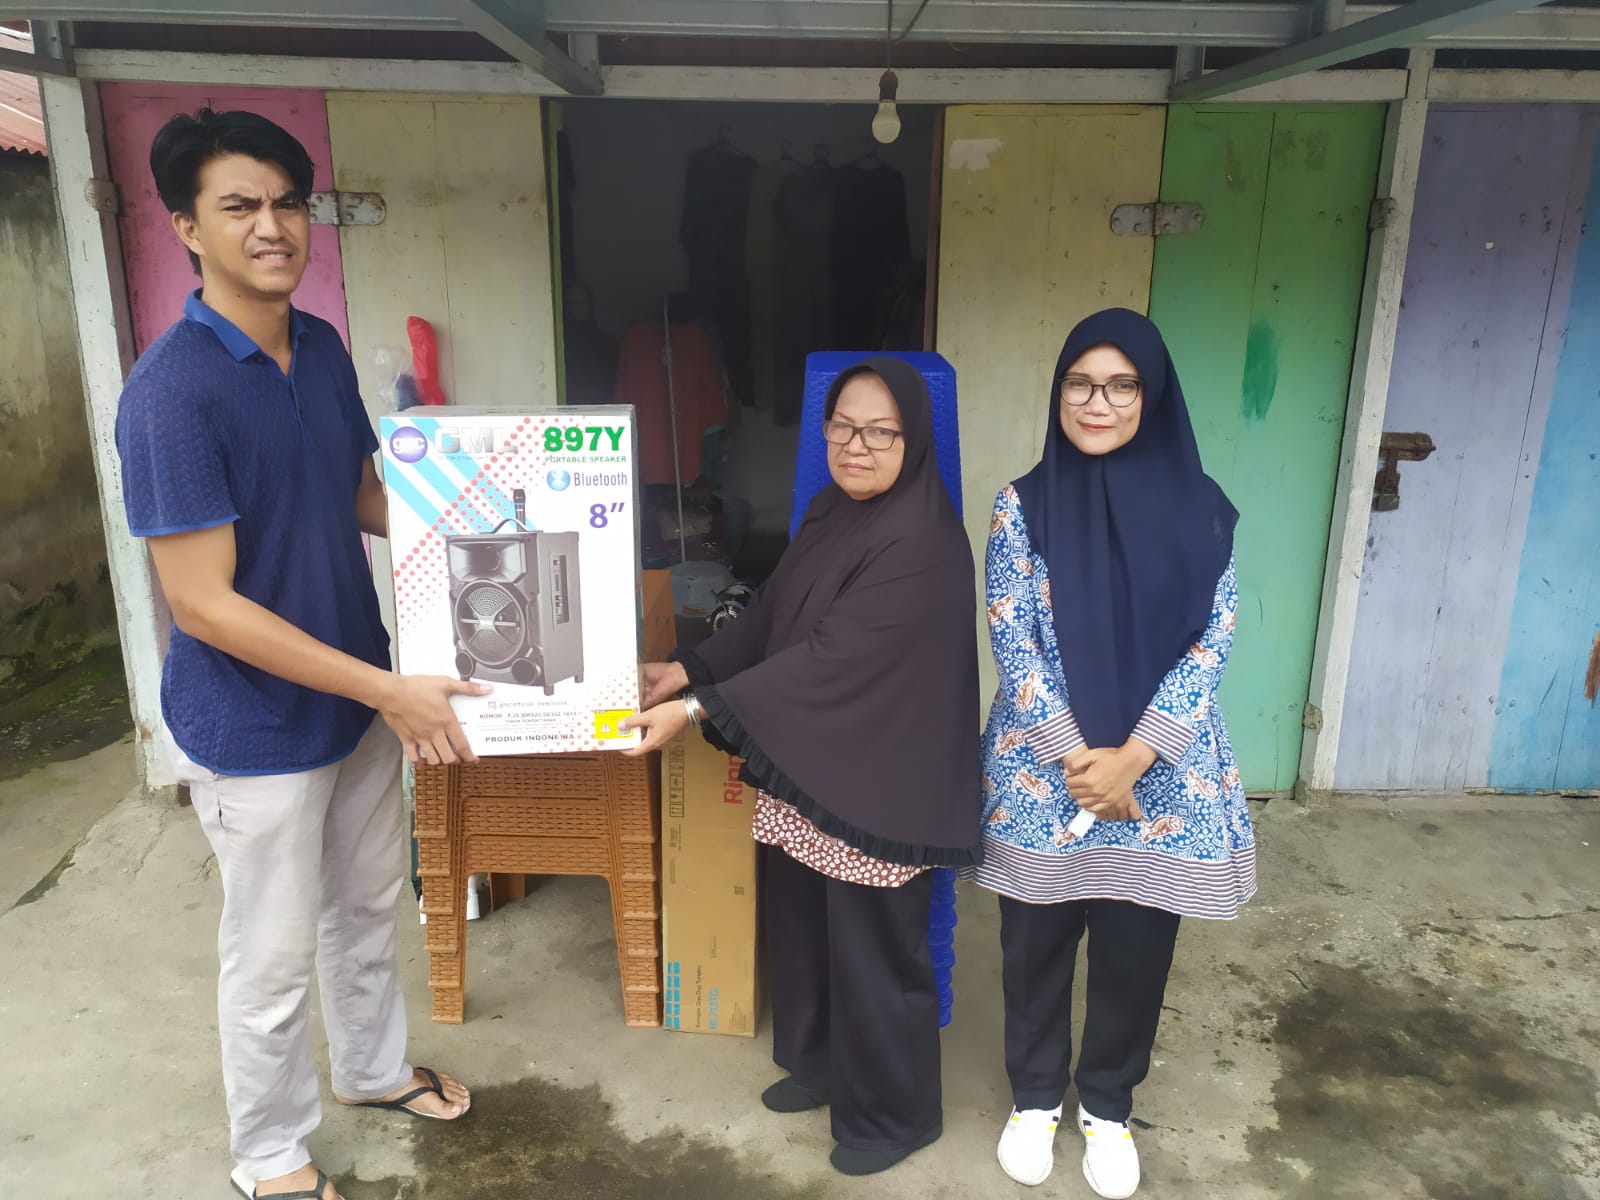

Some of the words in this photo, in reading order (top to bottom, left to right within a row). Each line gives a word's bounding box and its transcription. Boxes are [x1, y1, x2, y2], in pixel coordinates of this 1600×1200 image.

[544, 425, 625, 453] 897Y
[545, 455, 587, 464] PORTABLE
[589, 454, 626, 463] SPEAKER
[573, 471, 627, 487] Bluetooth
[485, 735, 523, 743] PRODUK
[525, 733, 575, 741] INDONESIA
